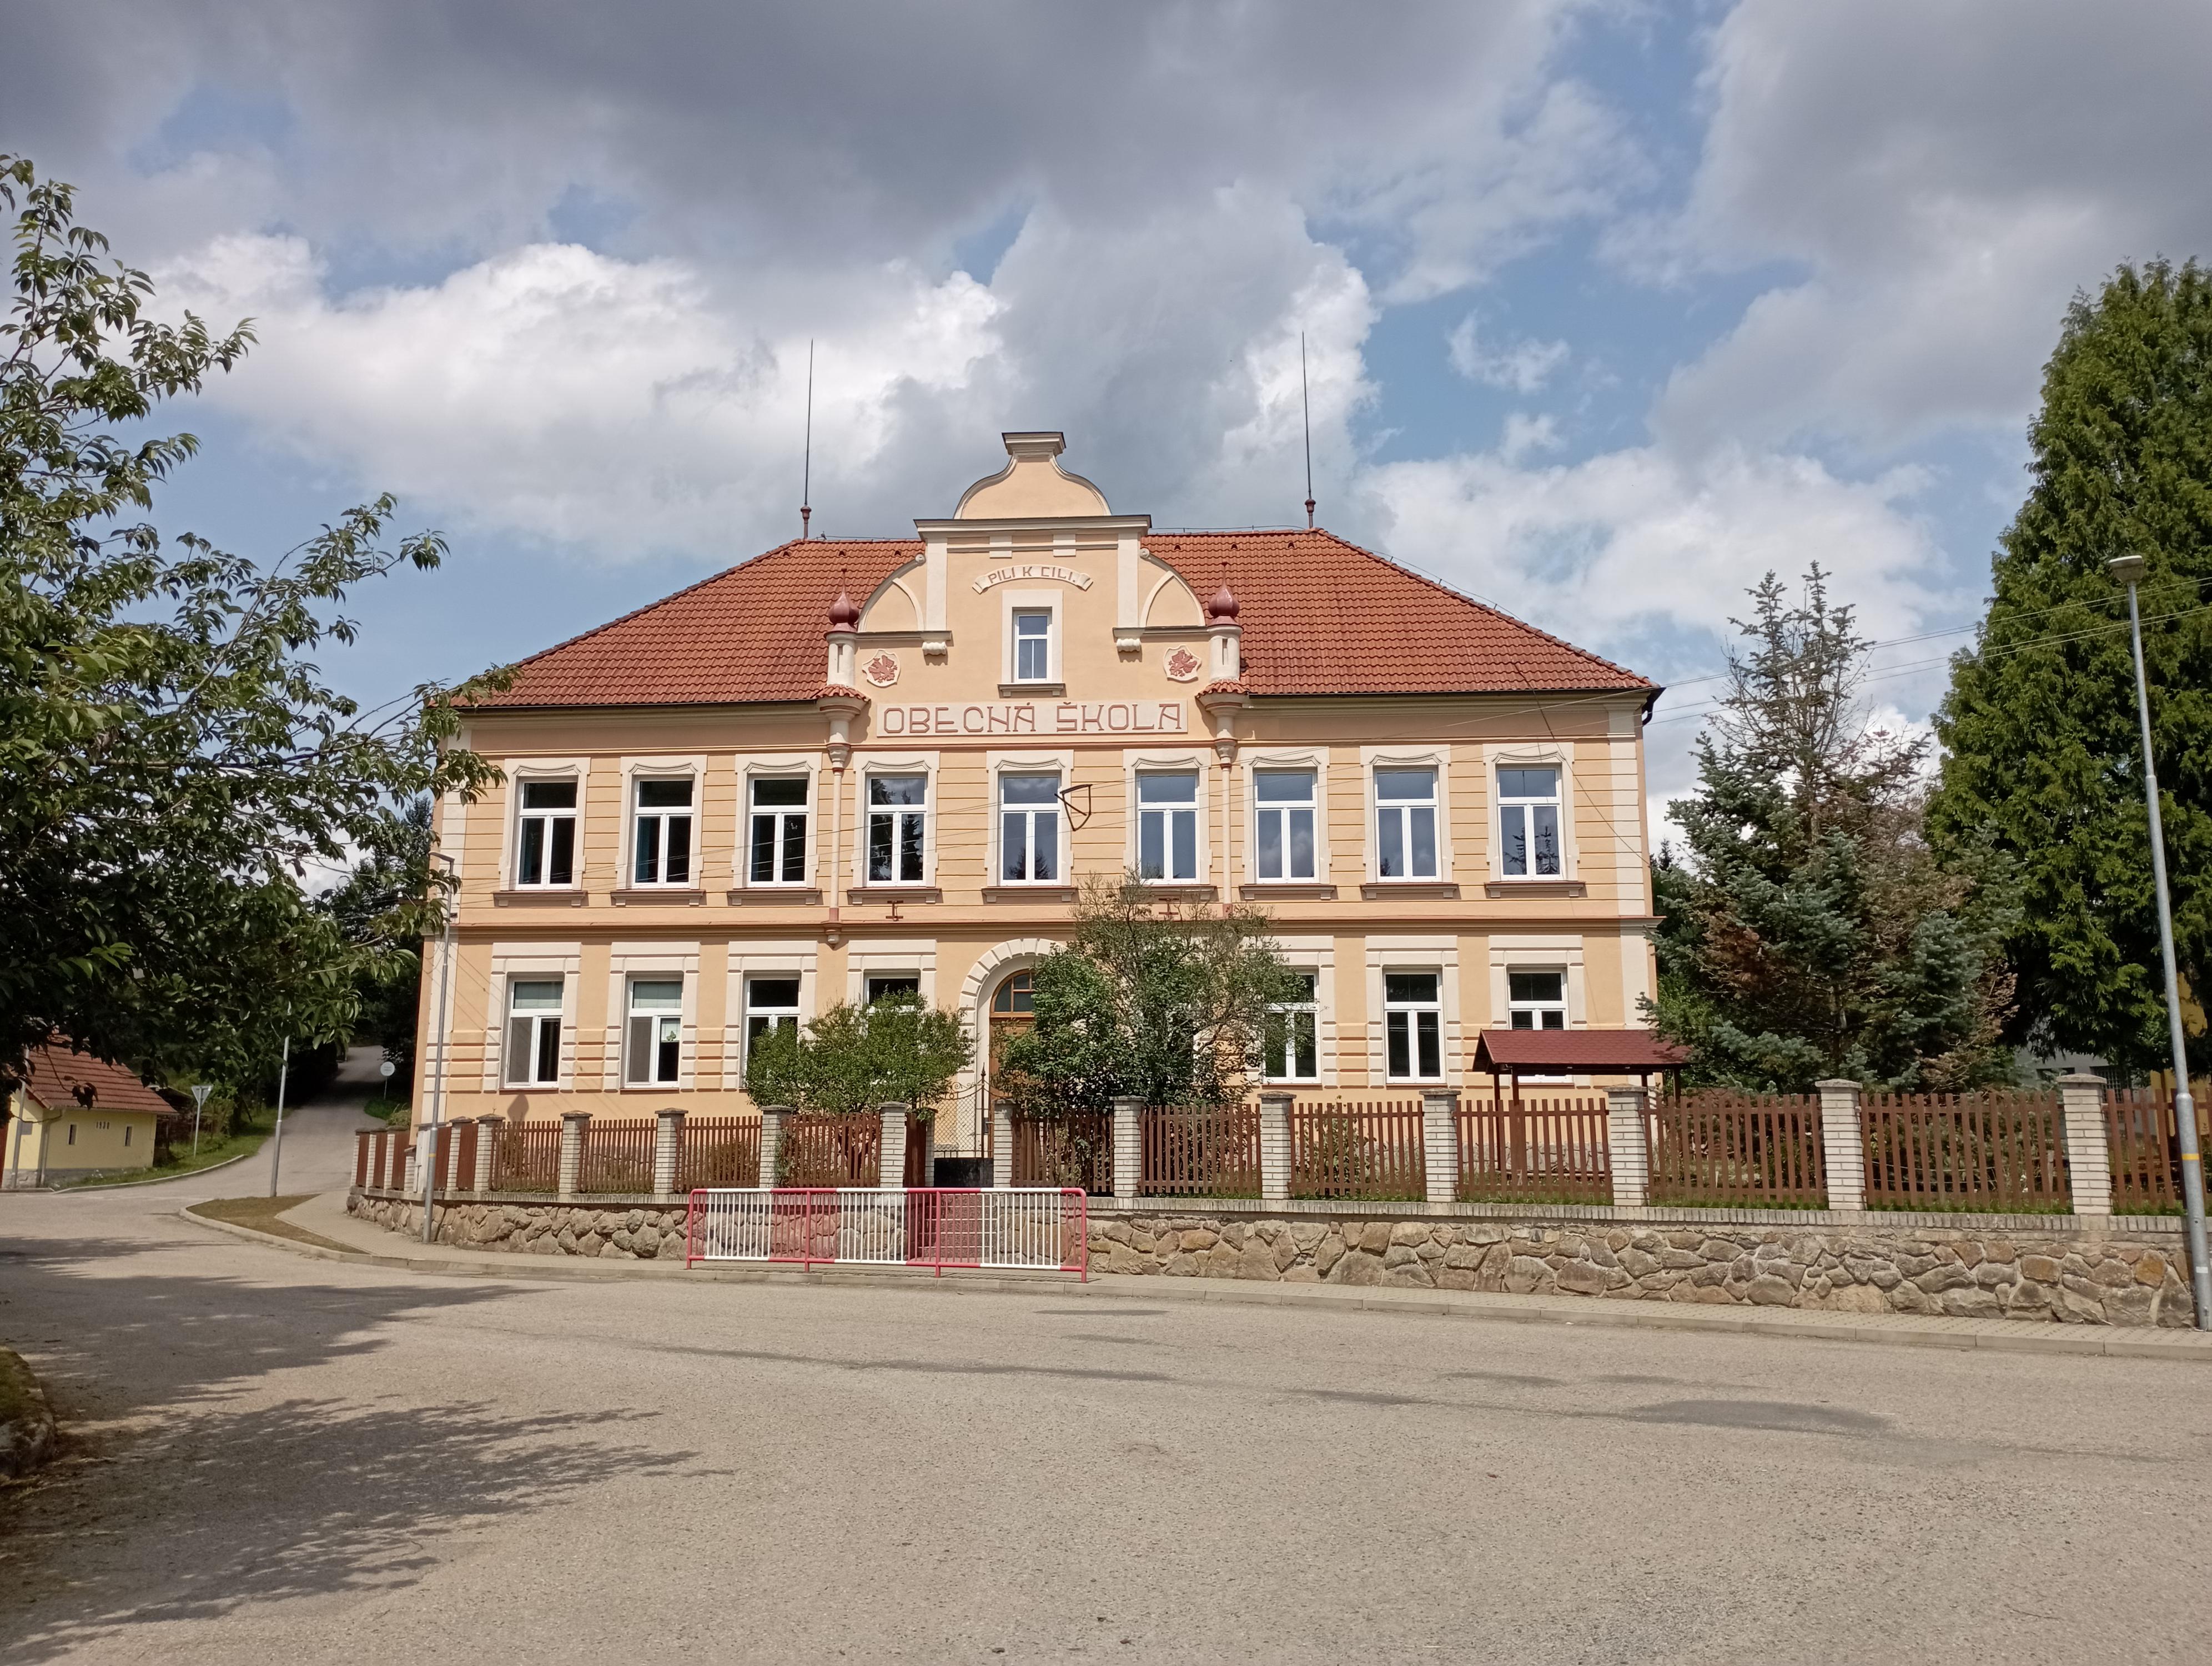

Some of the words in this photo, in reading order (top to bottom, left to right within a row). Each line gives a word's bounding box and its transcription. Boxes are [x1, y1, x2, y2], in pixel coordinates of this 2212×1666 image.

[1023, 566, 1032, 577] K
[884, 702, 1036, 734] OBECNÁ
[1057, 701, 1182, 732] ŠKOLA
